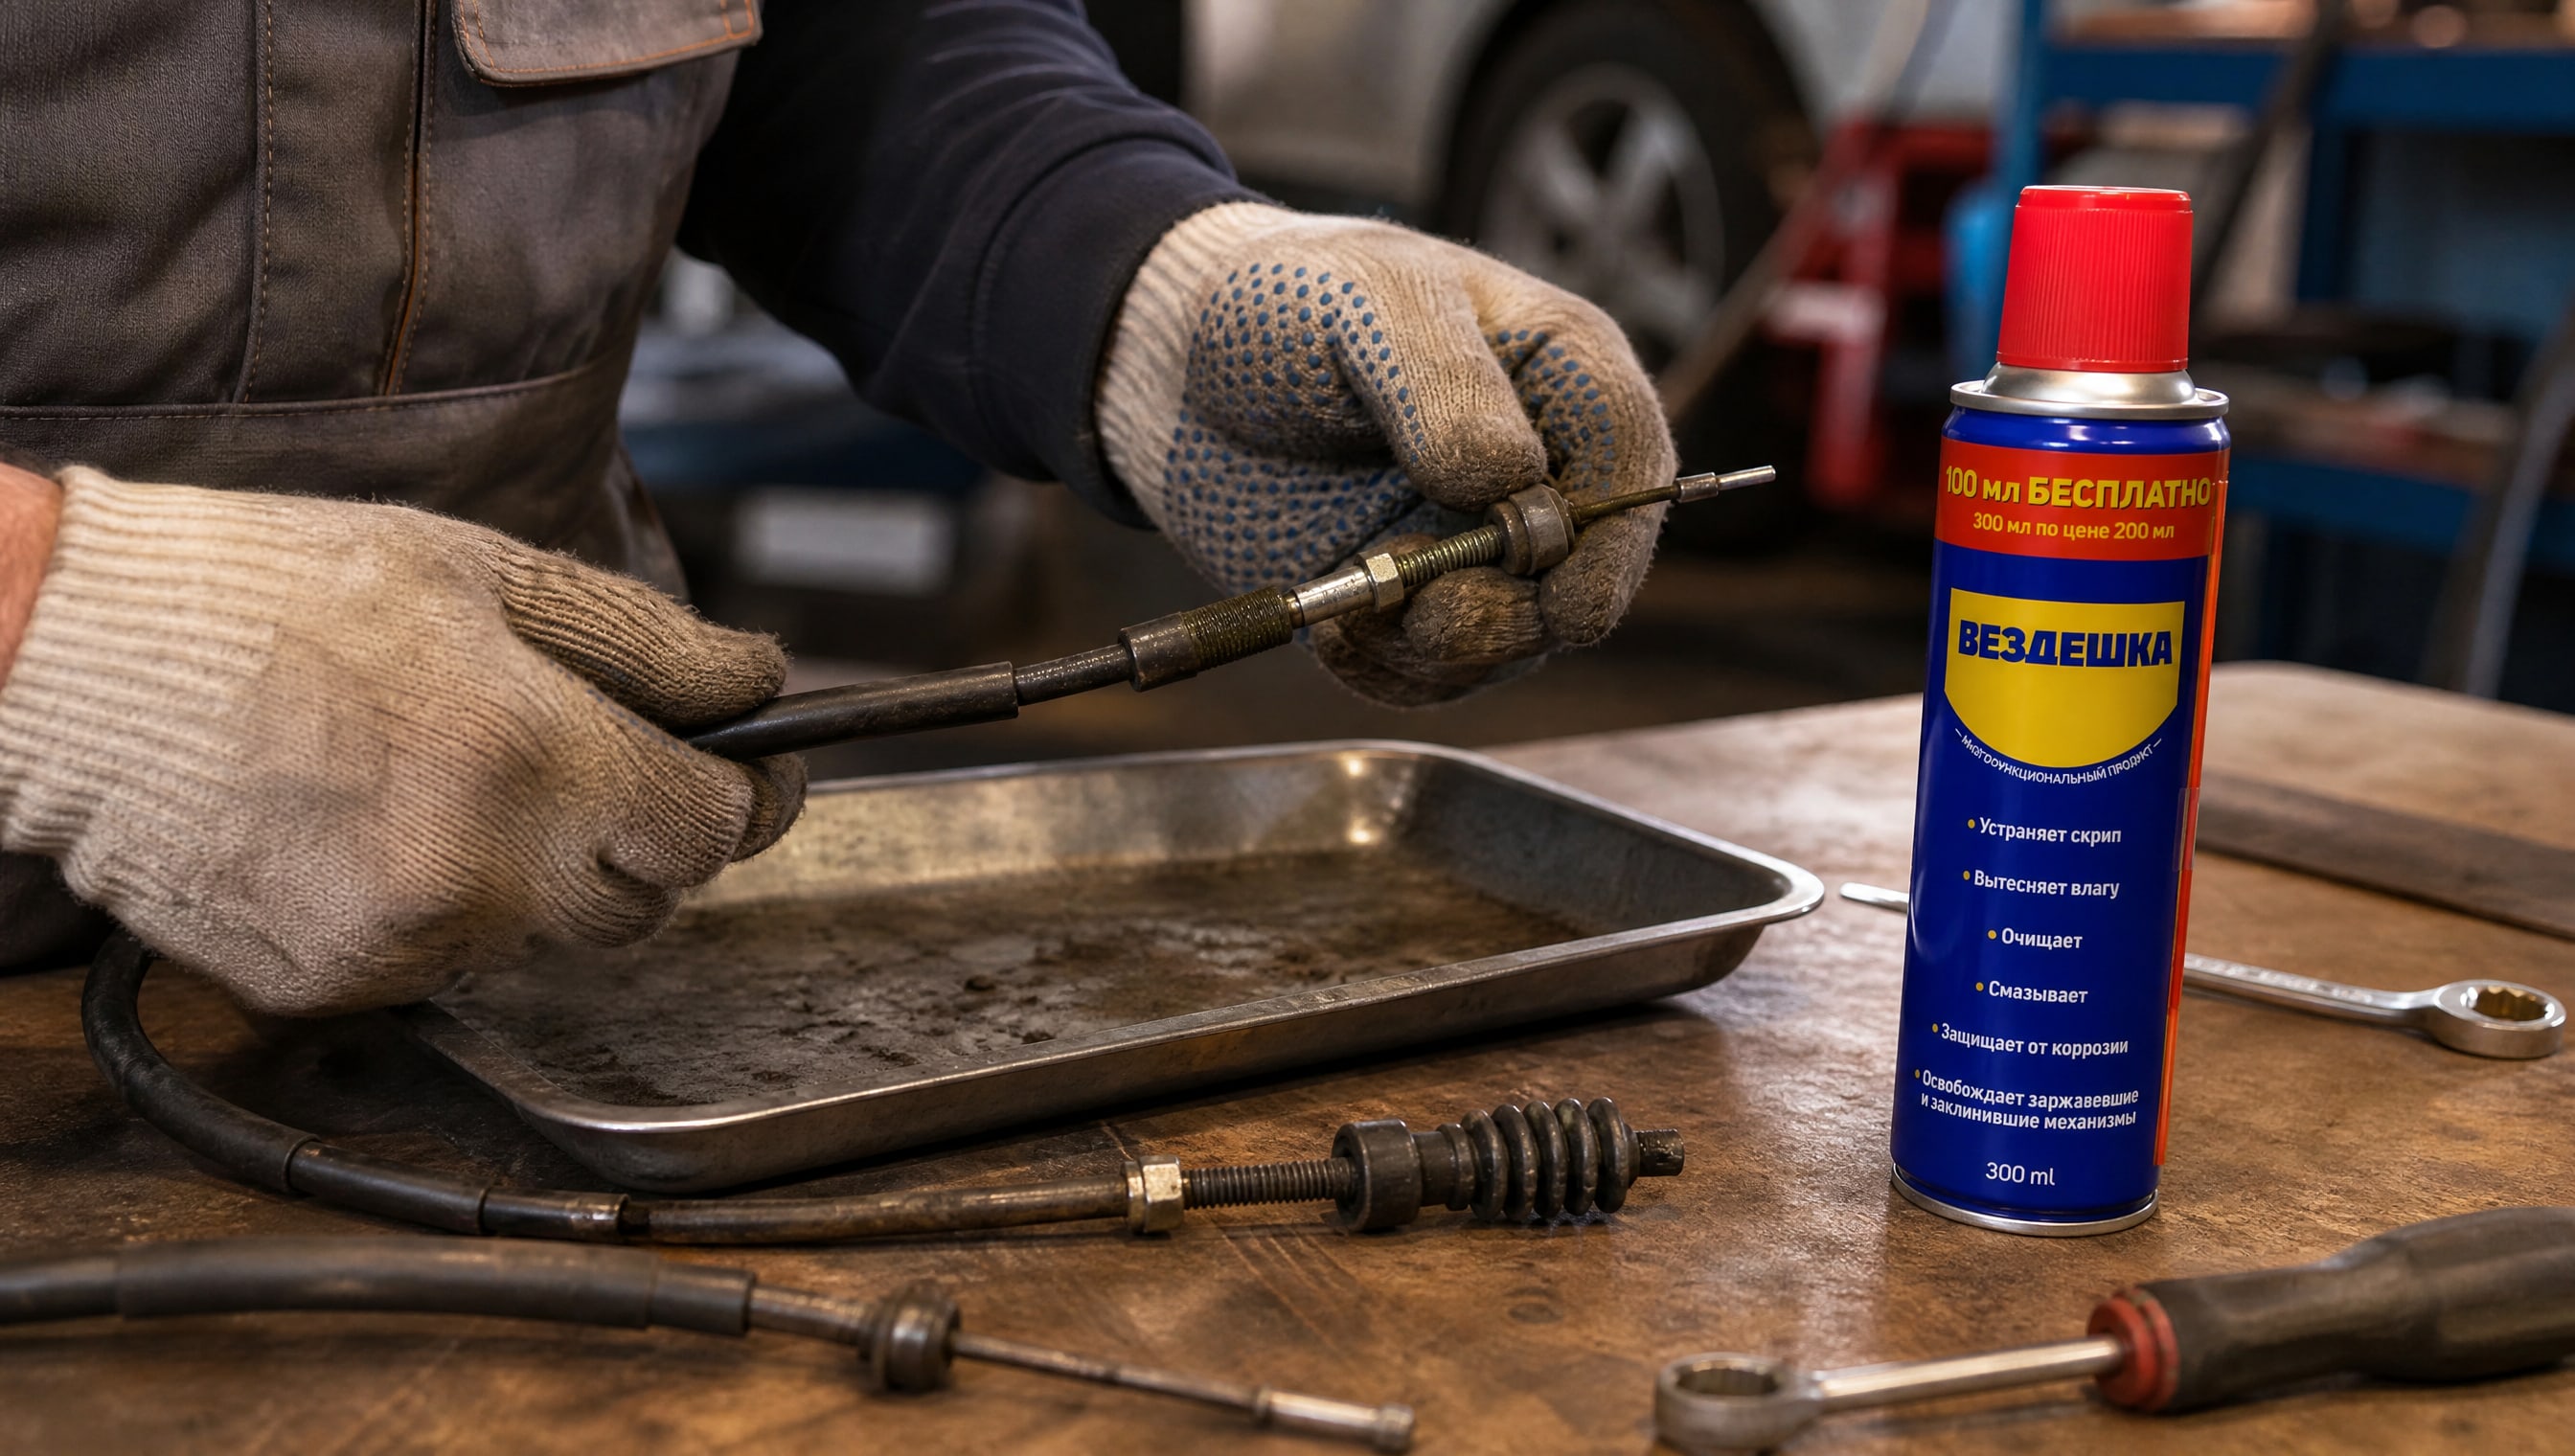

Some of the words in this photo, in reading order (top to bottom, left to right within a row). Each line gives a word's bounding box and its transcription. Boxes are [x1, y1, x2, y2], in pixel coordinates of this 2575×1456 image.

[1946, 466, 1977, 498] 100
[1982, 478, 2020, 504] мл
[2027, 476, 2211, 510] БЕСПЛАТНО
[1972, 512, 2004, 533] 300
[2007, 520, 2031, 535] мл
[2036, 523, 2059, 537] по
[2062, 524, 2110, 541] цене
[2113, 522, 2149, 539] 200
[2153, 525, 2175, 538] мл
[1958, 619, 2173, 668] ВЕЗДЕШКА
[1979, 816, 2067, 843] Устраняет
[2070, 830, 2122, 848] скрип
[1973, 869, 2068, 897] Вытесняет
[2070, 882, 2120, 899] влагу
[2001, 927, 2084, 950] Очищает
[1989, 980, 2088, 1004] Смазывает
[1941, 1022, 2025, 1054] Защищает
[2027, 1041, 2049, 1055] от
[2051, 1038, 2129, 1060] коррозии
[1922, 1069, 2025, 1107] Освобождает
[2027, 1089, 2139, 1112] заржавевшие
[1921, 1092, 1929, 1107] и
[1930, 1096, 2040, 1129] заклинившие
[2043, 1110, 2137, 1130] механизмы
[1985, 1161, 2025, 1185] 300
[2030, 1168, 2056, 1187] ml
